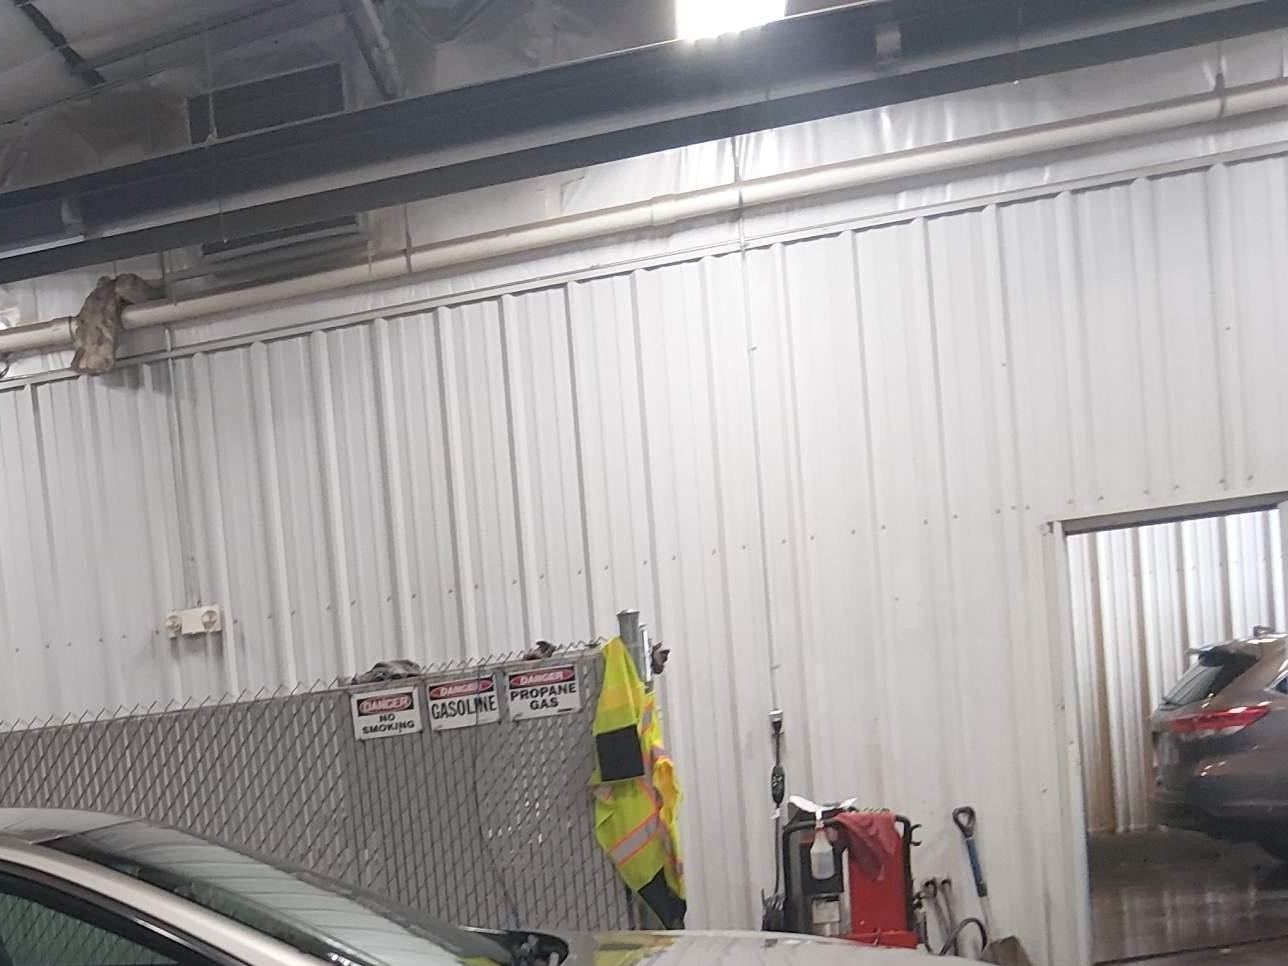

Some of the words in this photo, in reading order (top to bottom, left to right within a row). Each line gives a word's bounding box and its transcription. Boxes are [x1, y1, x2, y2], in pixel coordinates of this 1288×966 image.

[519, 670, 563, 686] DANGER
[510, 683, 576, 701] PROPANE
[360, 695, 409, 712] DANGER
[432, 695, 497, 720] GASOLINE
[529, 697, 559, 710] GAS
[379, 713, 396, 722] NO
[362, 719, 415, 734] SMOKING
